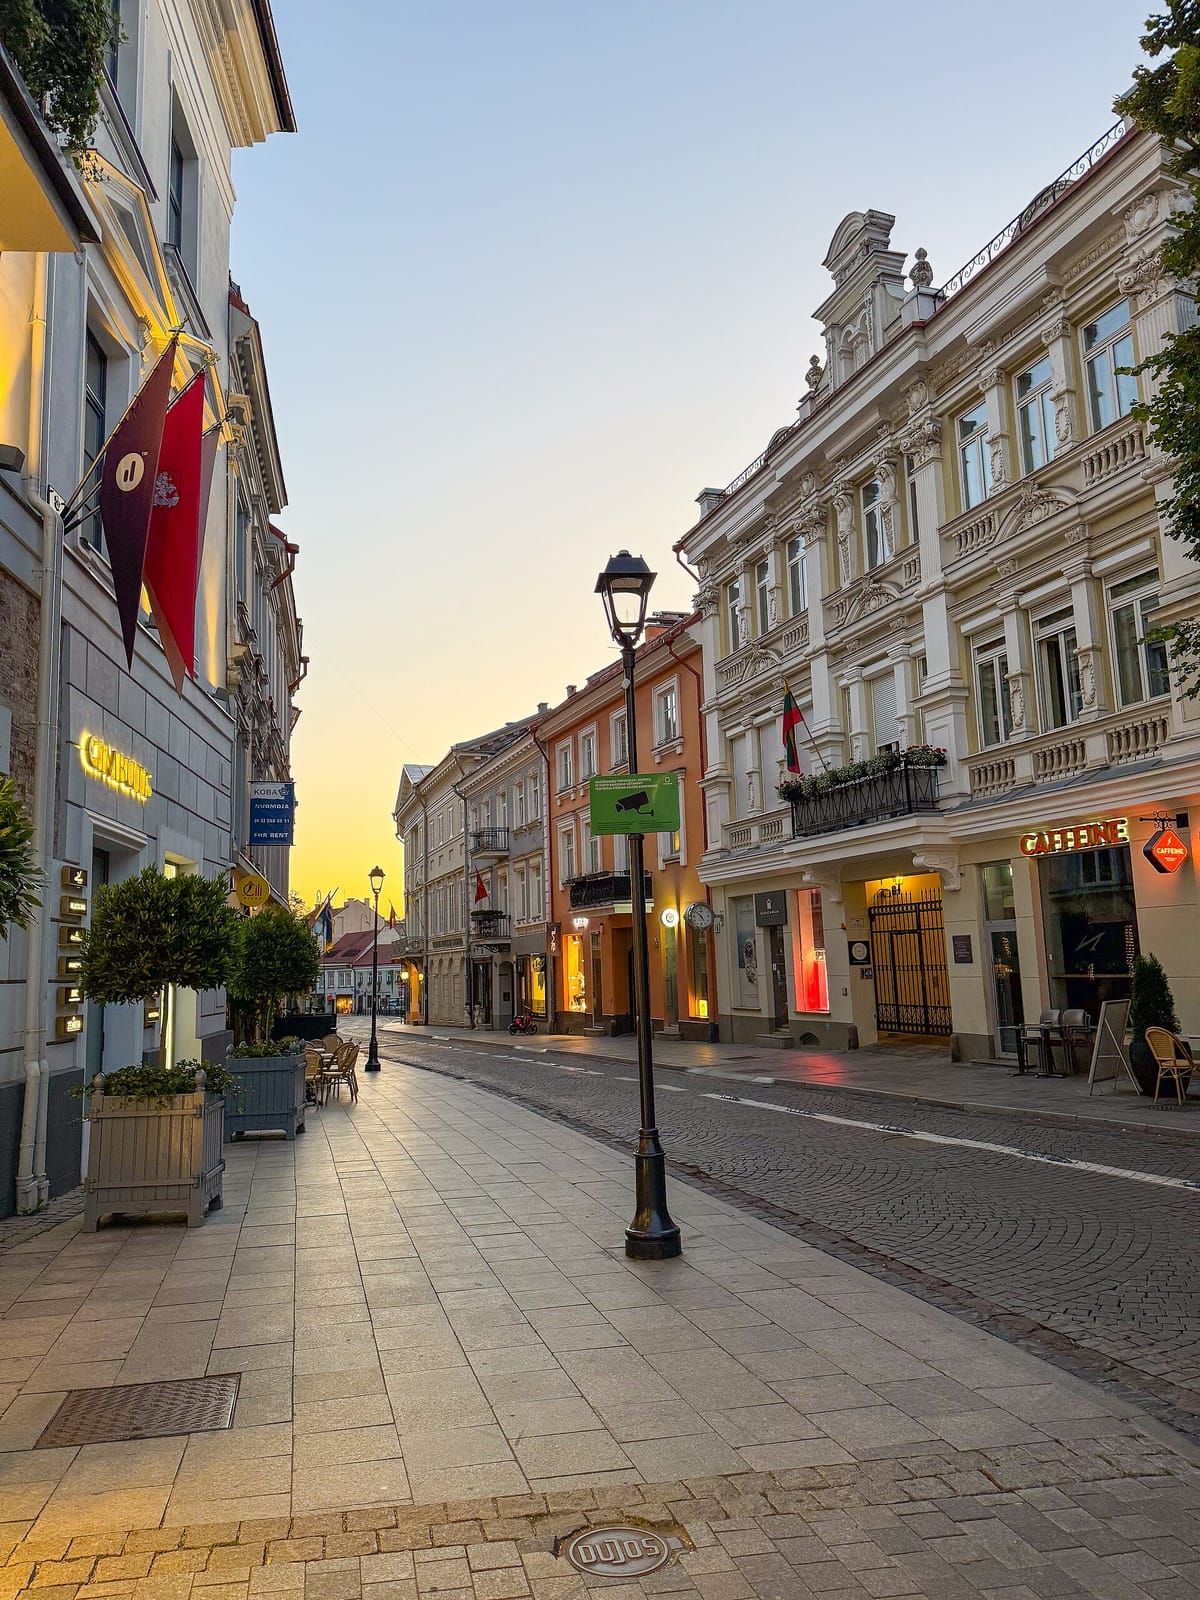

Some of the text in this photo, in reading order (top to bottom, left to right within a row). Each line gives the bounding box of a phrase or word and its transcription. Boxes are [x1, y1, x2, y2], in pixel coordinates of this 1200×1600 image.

[1020, 818, 1128, 856] CAFFEINE
[1156, 847, 1184, 855] CAFFEINE
[578, 1538, 660, 1564] DUJOS
